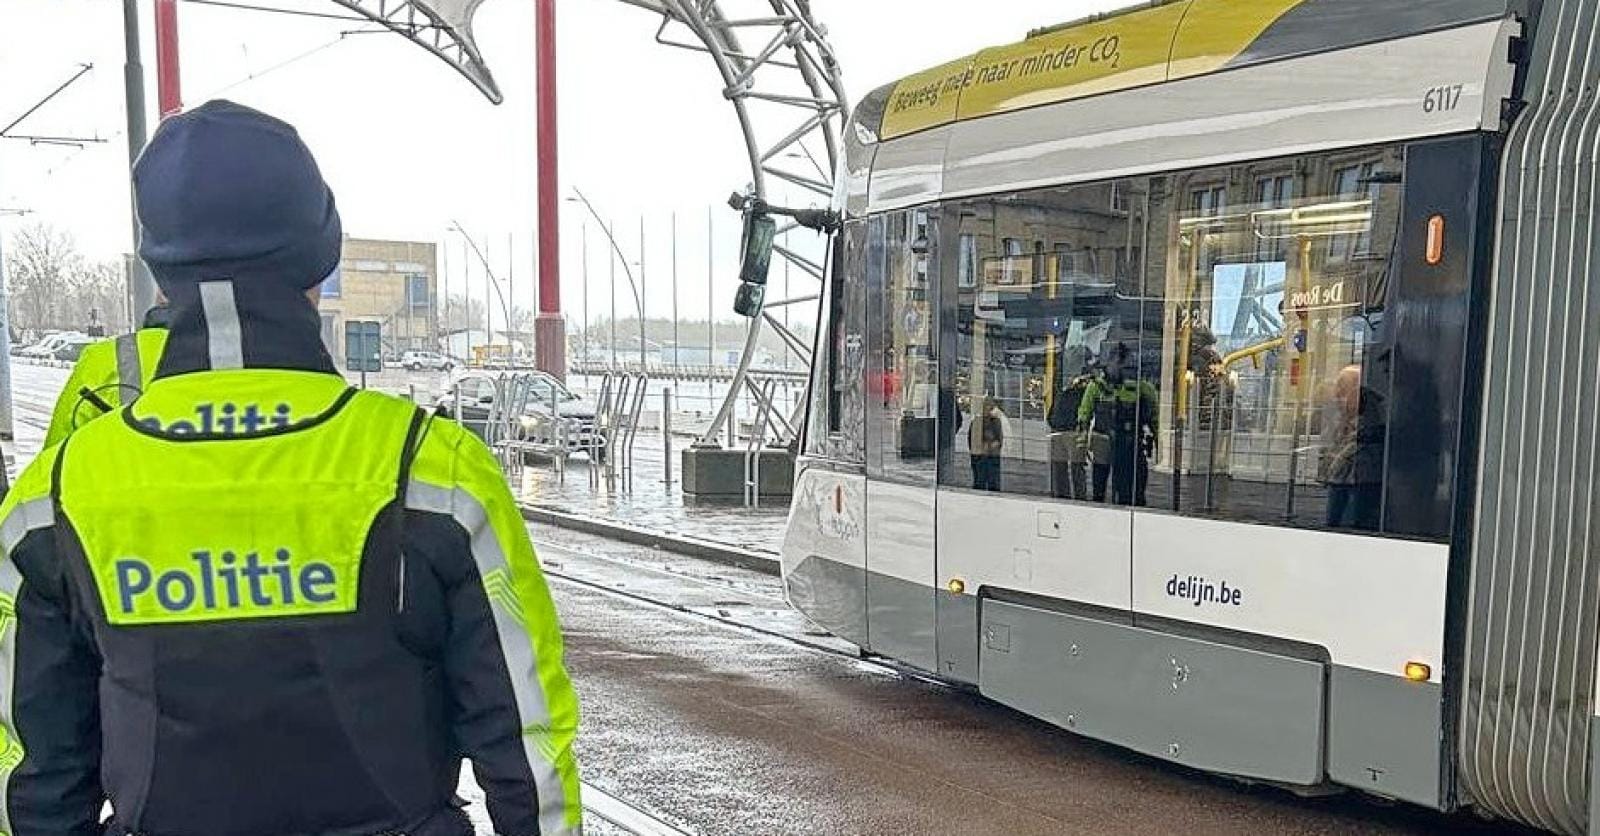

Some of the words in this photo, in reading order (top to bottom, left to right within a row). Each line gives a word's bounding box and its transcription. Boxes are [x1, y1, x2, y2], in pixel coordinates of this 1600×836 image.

[976, 60, 1018, 84] naar
[1020, 44, 1087, 77] minder
[1423, 85, 1463, 112] 6117
[115, 548, 337, 613] Politie
[1166, 574, 1242, 606] delijn.be
